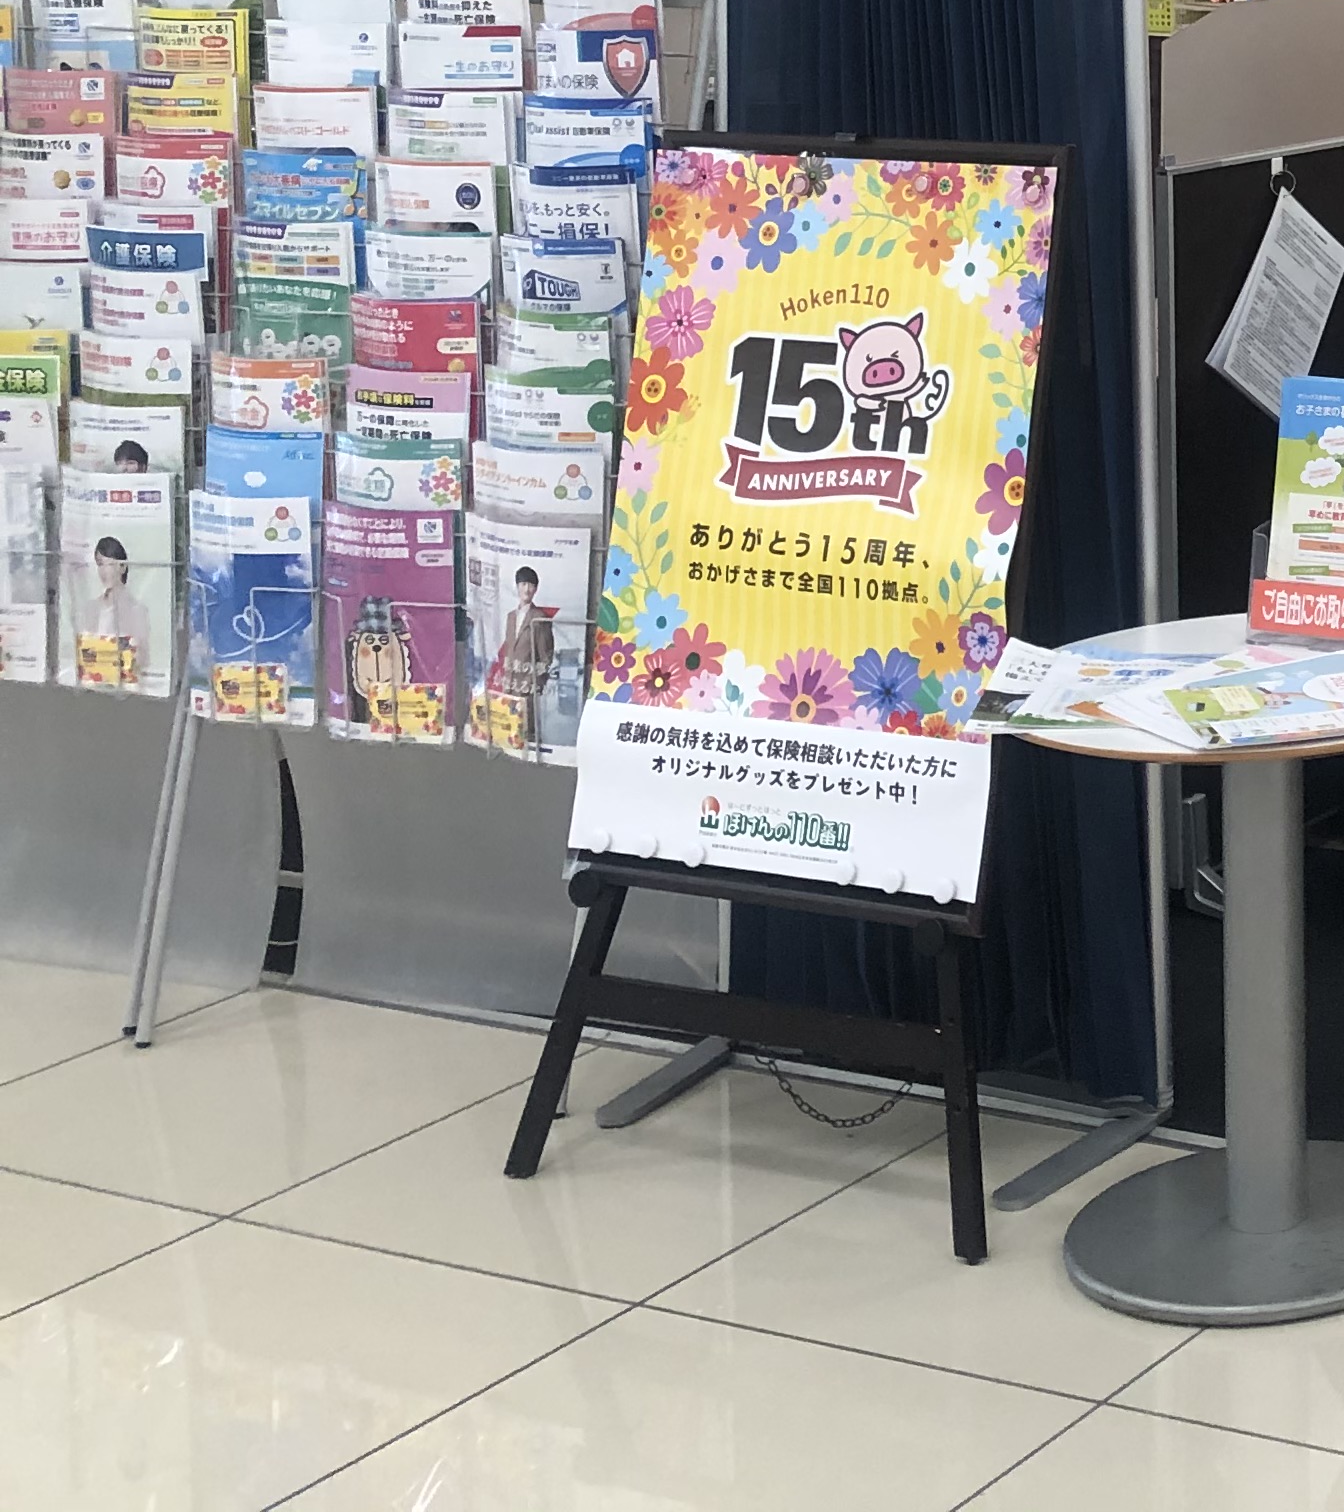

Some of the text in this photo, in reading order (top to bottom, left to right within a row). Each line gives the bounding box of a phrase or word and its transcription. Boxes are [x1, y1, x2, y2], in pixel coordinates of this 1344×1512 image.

[779, 283, 891, 321] Hoken110
[747, 468, 893, 492] ANNIVERSARY
[690, 522, 930, 570] ありがとう15周年、
[687, 561, 929, 605] おかげさまで全国110拠点。
[615, 720, 958, 779] 感謝の気持を込めて保険相談いただいた方に
